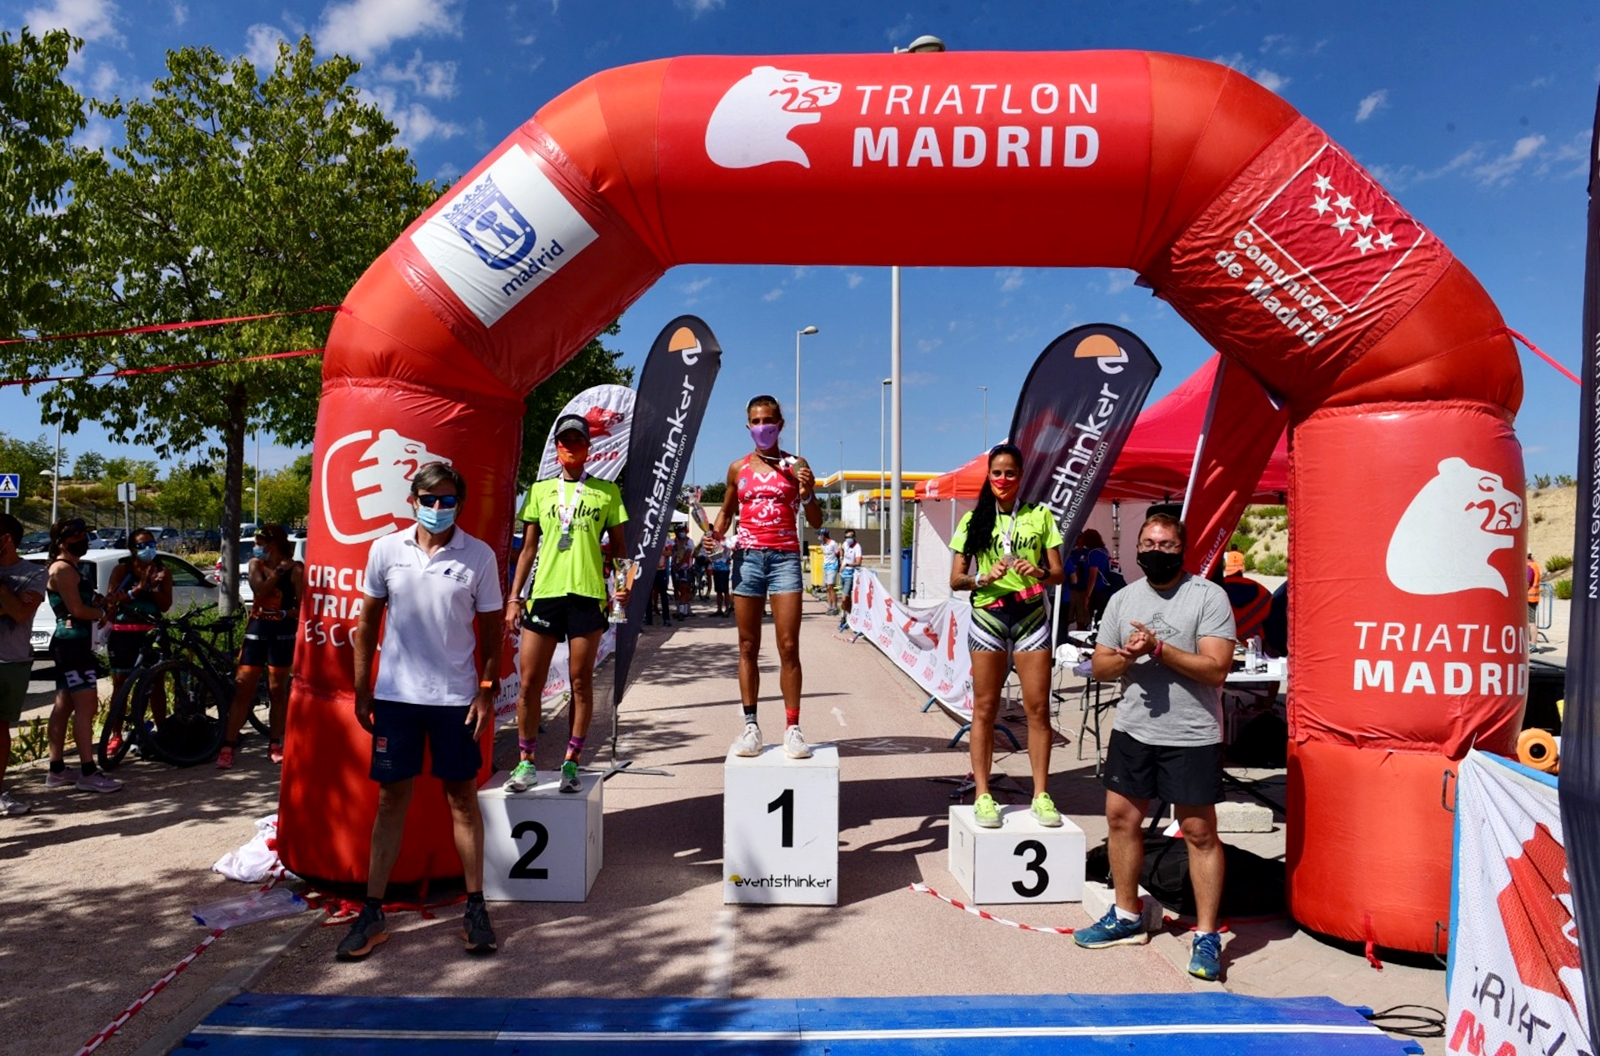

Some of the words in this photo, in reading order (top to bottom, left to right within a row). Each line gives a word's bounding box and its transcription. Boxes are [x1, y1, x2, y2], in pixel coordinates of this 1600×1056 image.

[855, 83, 1098, 115] TRIATLON
[852, 125, 1099, 168] MADRID
[502, 239, 564, 296] madrid
[1233, 229, 1344, 331] Comunidad
[1215, 250, 1243, 279] de
[1245, 276, 1325, 348] Madrid
[650, 434, 688, 549] www.eventsthinker.com
[307, 564, 365, 593] CIRCU
[312, 592, 364, 620] TRIA
[1353, 621, 1528, 654] TRIATLON
[1352, 659, 1528, 696] MADRID
[766, 788, 795, 849] 1
[508, 820, 550, 880] 2
[1012, 839, 1051, 898] 3
[731, 874, 832, 890] eventsthinker
